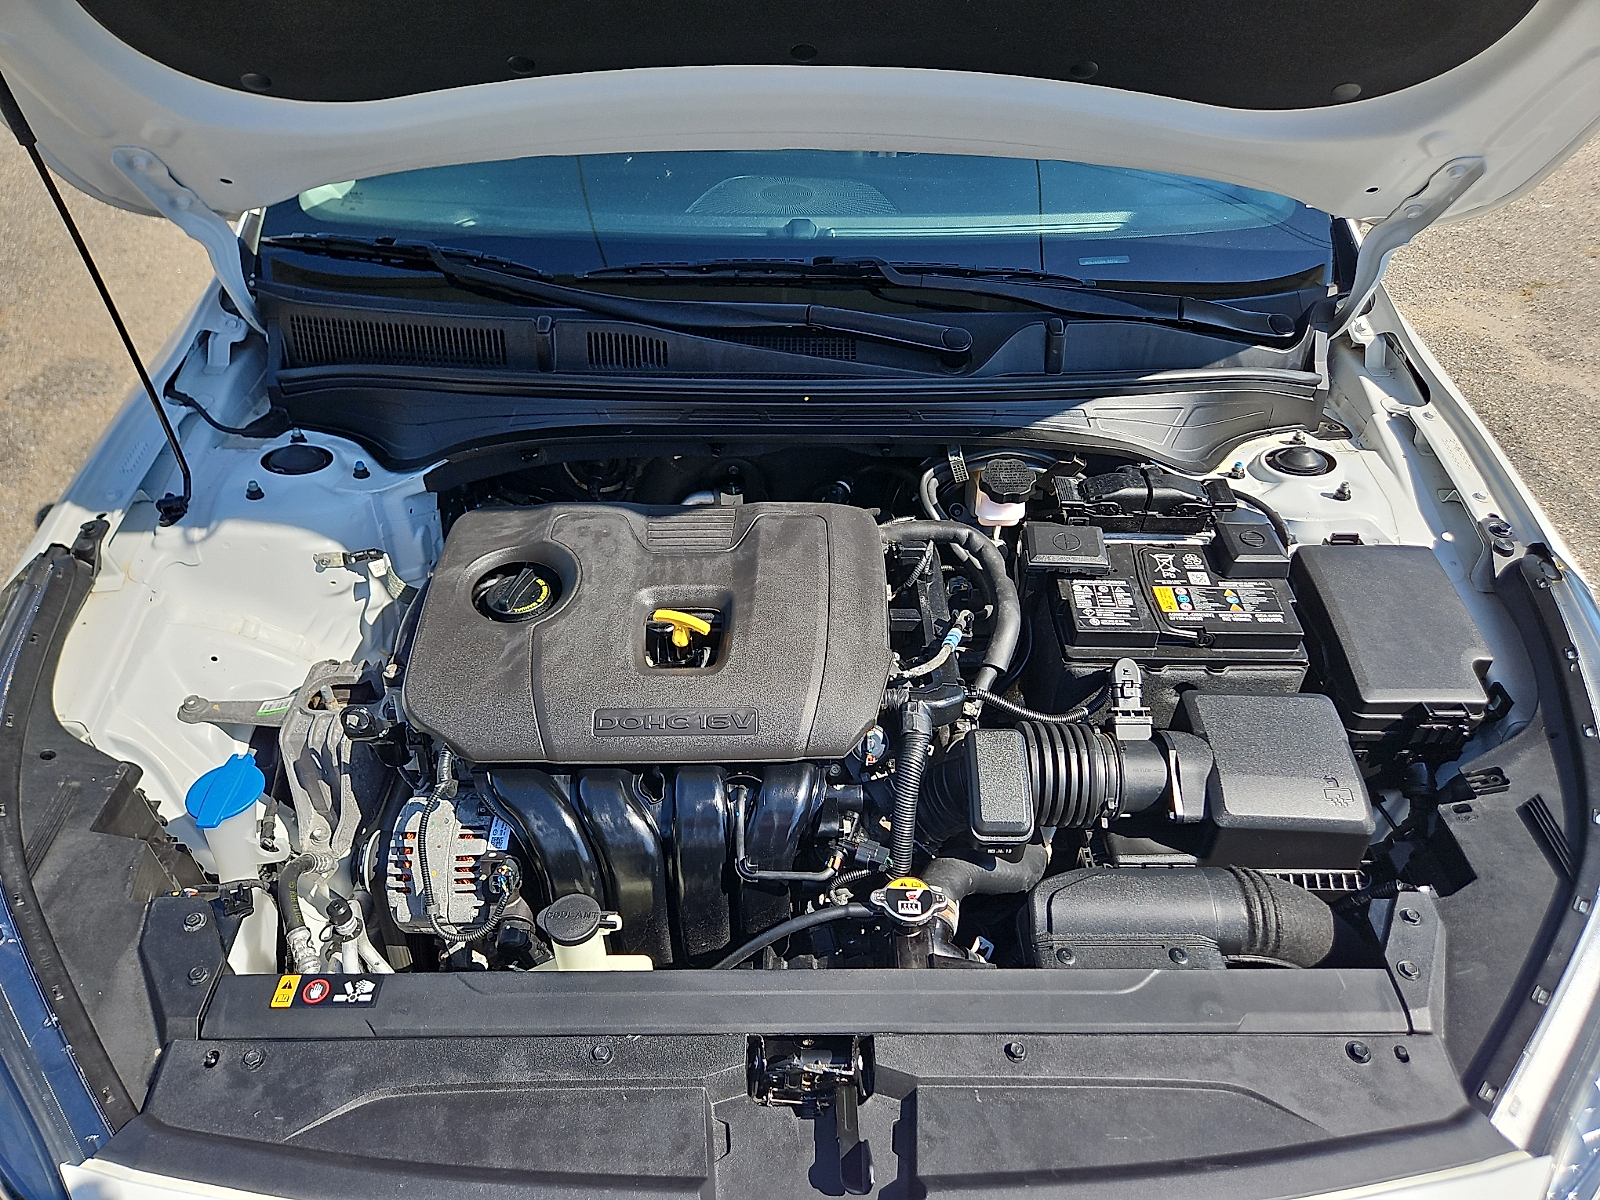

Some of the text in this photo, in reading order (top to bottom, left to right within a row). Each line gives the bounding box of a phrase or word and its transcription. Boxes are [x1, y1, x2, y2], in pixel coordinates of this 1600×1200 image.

[595, 713, 755, 730] DOHC 16V
[547, 911, 600, 920] COOLANT
